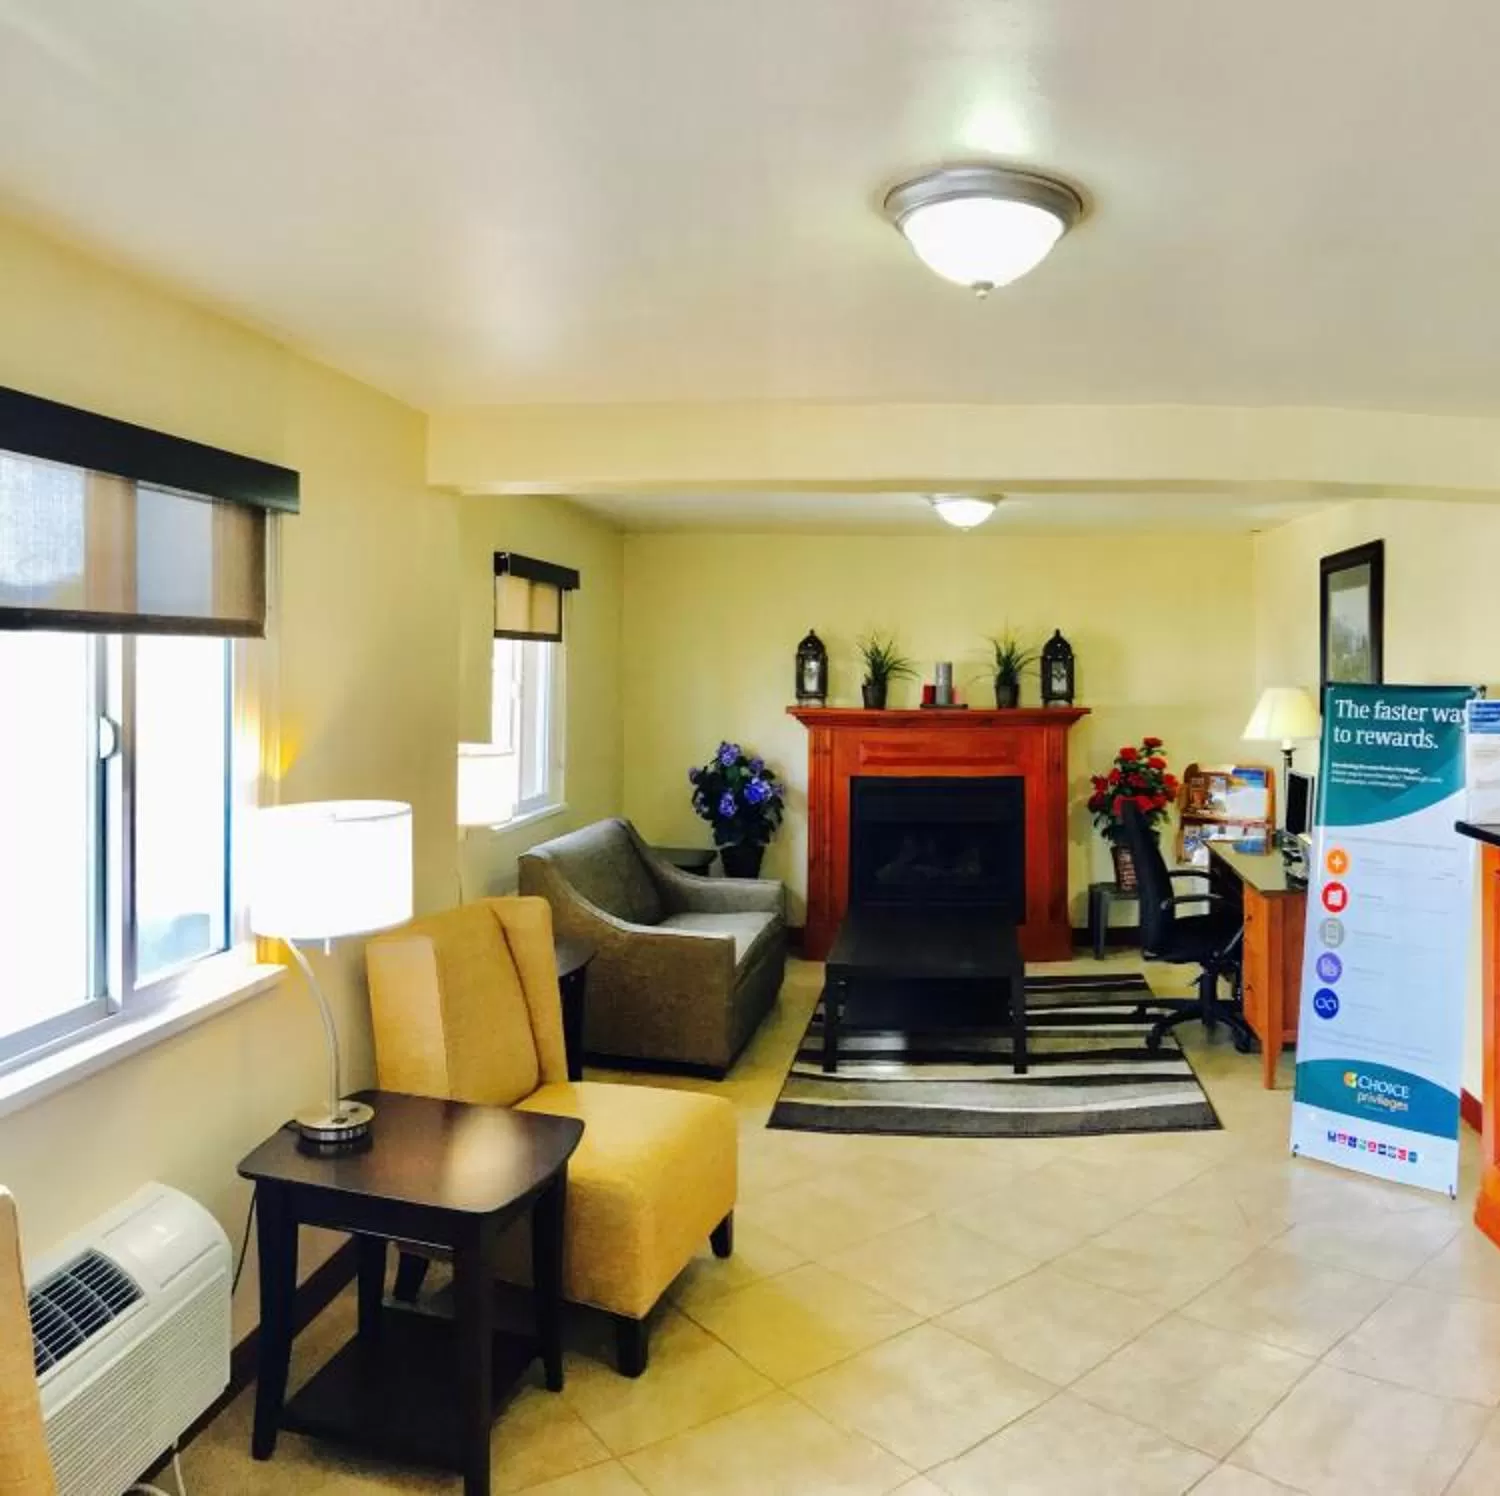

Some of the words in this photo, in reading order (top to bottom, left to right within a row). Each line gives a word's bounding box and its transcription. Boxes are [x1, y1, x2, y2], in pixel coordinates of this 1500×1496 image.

[1335, 699, 1370, 719] The
[1374, 700, 1428, 721] faster
[1333, 725, 1351, 743] to
[1355, 727, 1439, 749] rewards.
[1358, 1075, 1410, 1099] CHOICE
